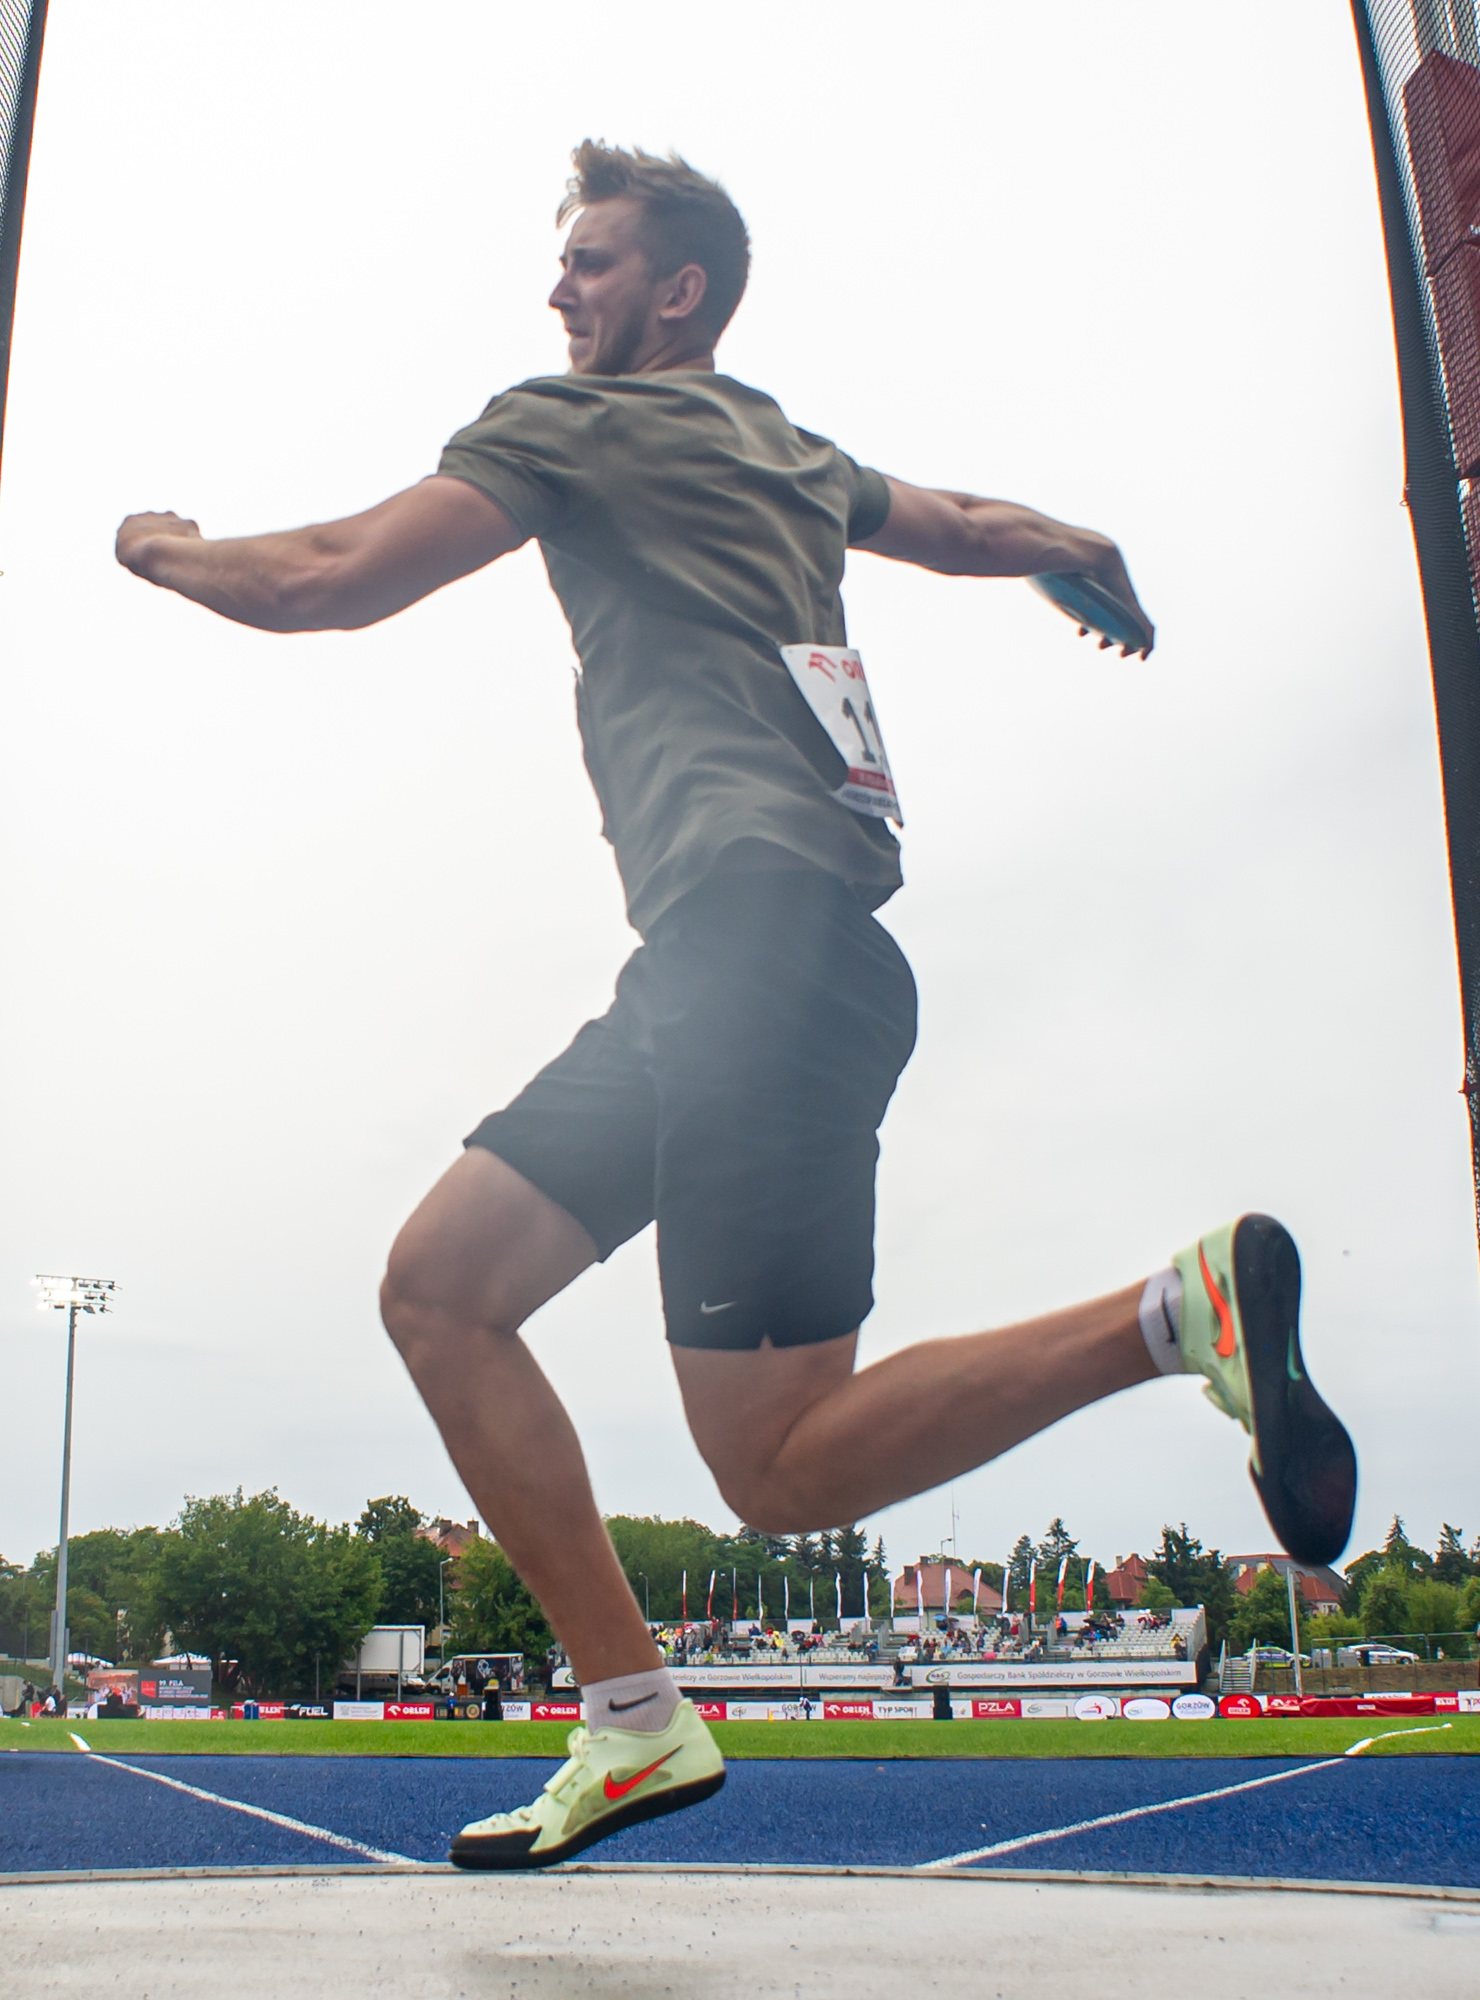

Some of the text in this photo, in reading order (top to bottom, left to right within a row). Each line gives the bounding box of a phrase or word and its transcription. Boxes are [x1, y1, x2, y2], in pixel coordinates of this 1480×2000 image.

[957, 1671, 1005, 1681] Gospodarczy
[1007, 1671, 1026, 1679] Bank
[1086, 1669, 1122, 1678] Gorzowie
[1124, 1668, 1181, 1678] Wielkopolskim
[403, 1706, 430, 1715] ORLEN
[550, 1706, 577, 1715] ORLEN
[842, 1705, 869, 1714] ORLEN
[978, 1702, 1015, 1712] PZLA
[1176, 1701, 1210, 1711] GORZÓW
